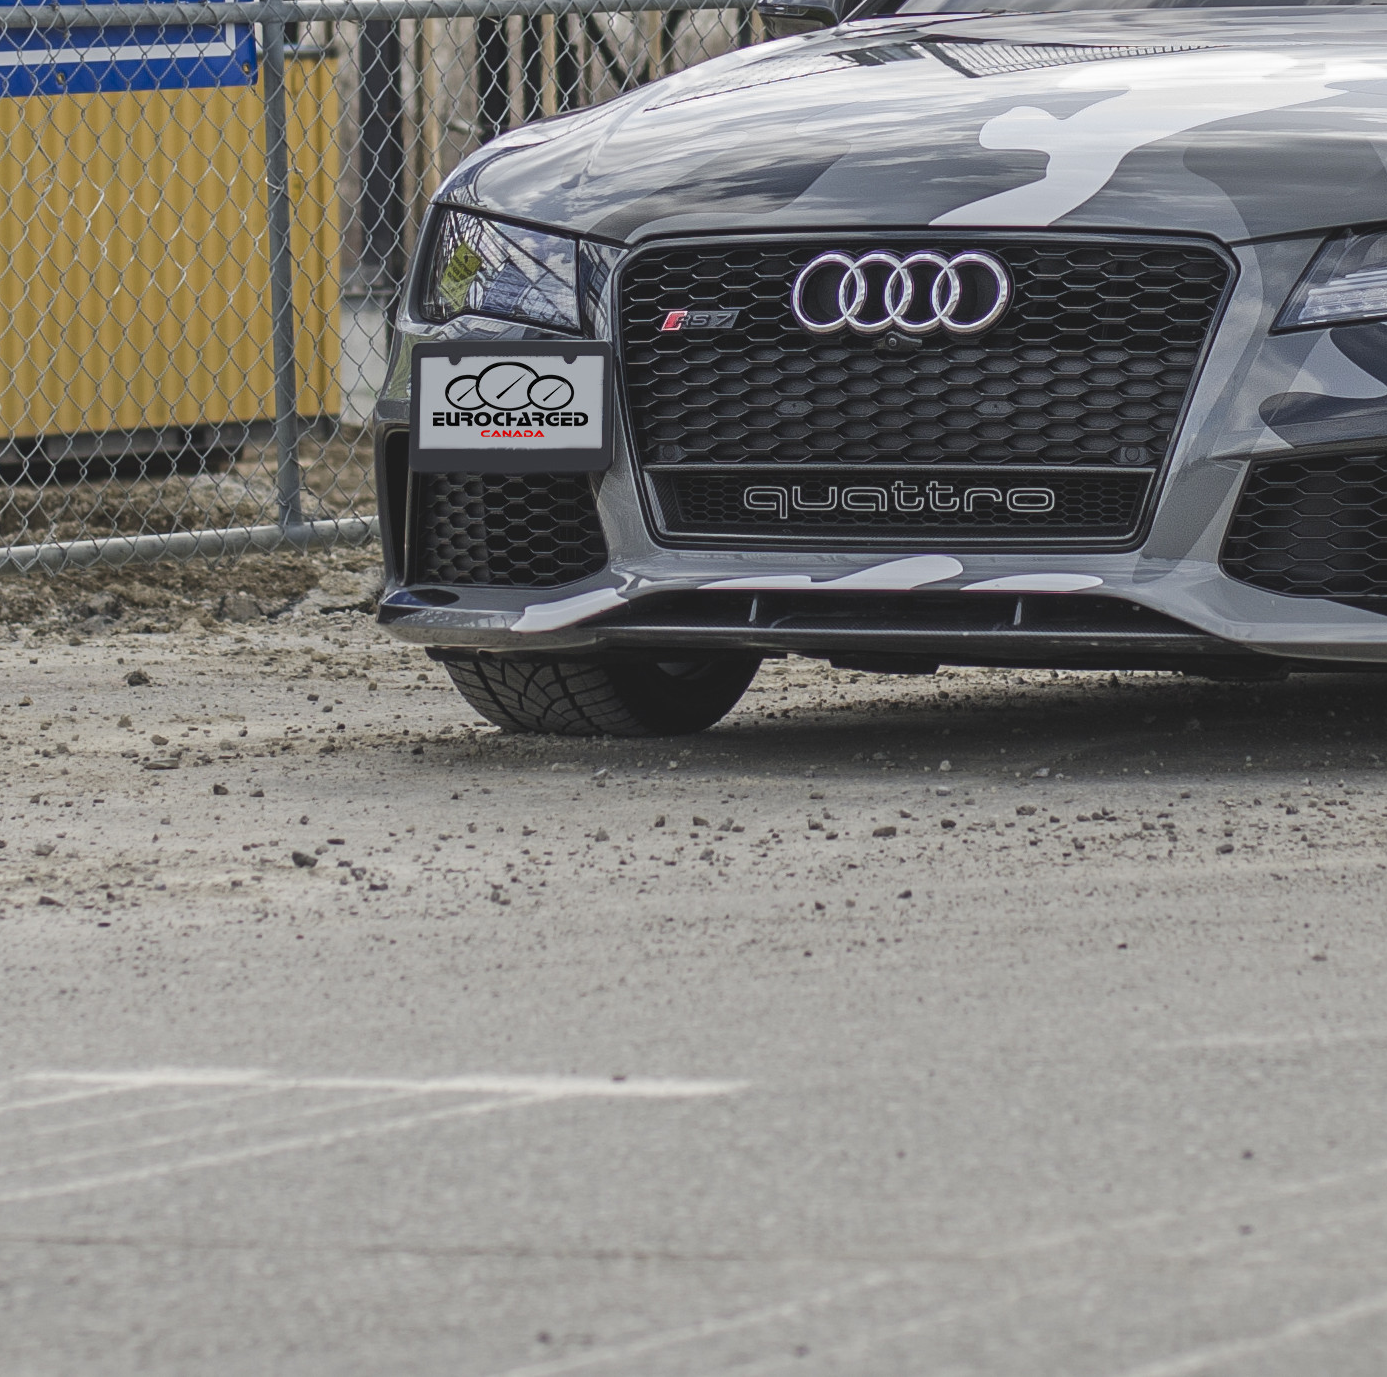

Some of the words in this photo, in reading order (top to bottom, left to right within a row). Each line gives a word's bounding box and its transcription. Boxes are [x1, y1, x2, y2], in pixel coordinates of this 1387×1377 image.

[432, 411, 589, 427] EUROCHARGED
[480, 429, 545, 438] CANADA
[743, 480, 1056, 520] quattro
